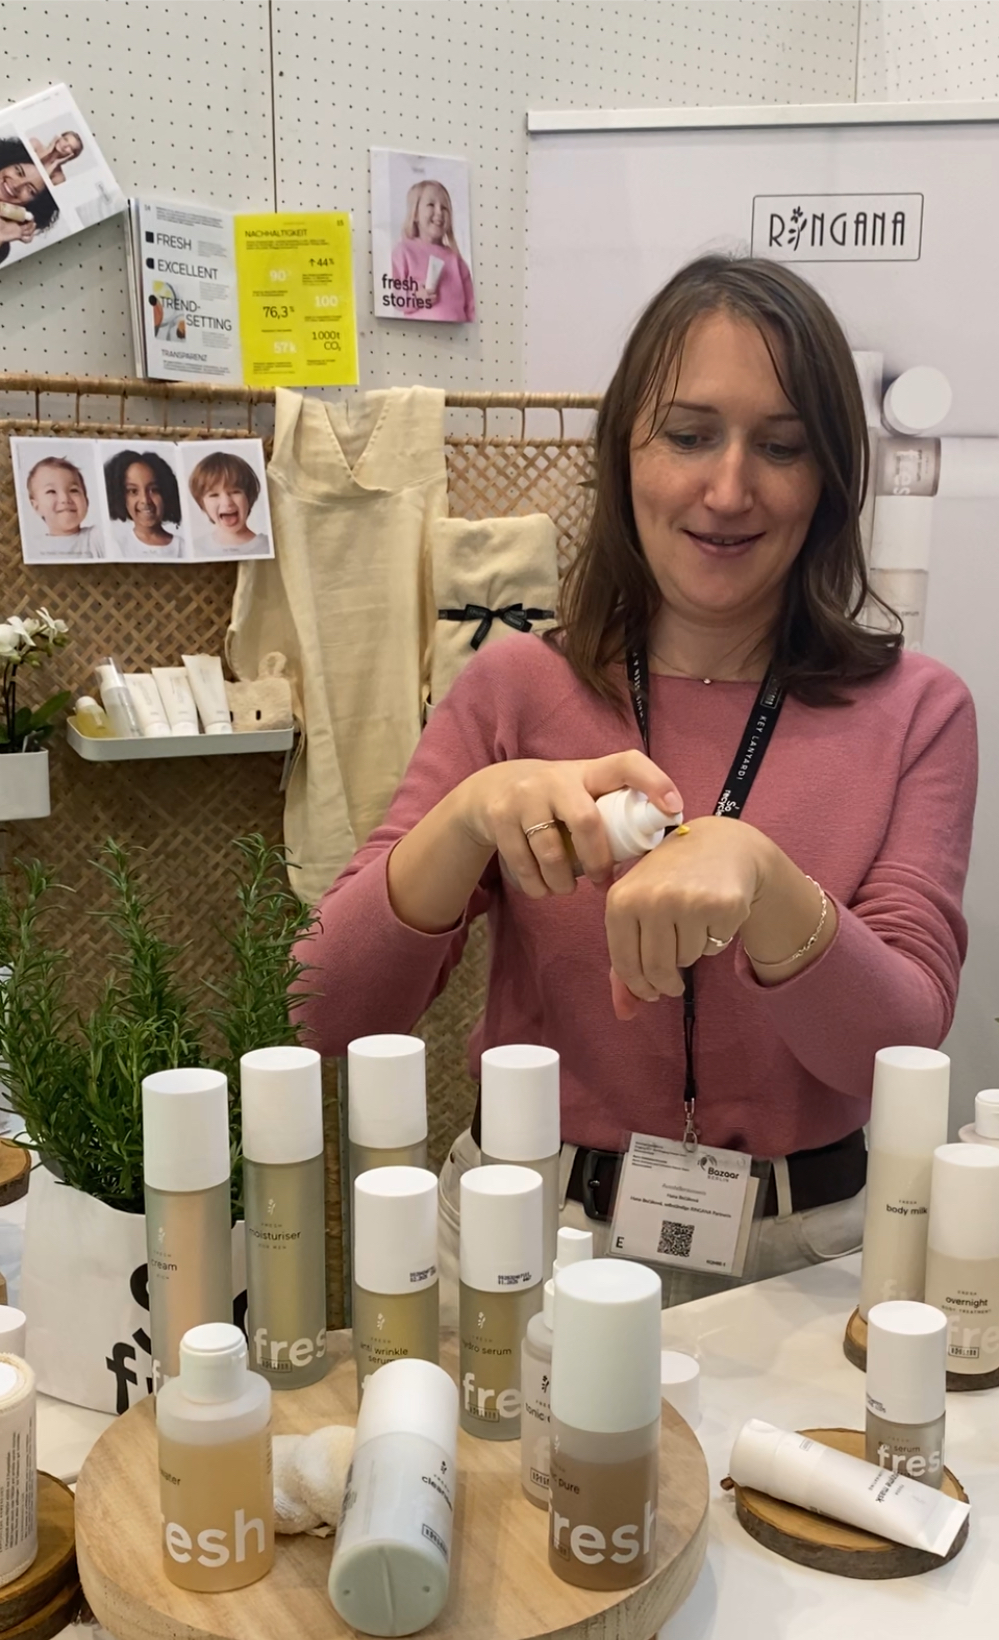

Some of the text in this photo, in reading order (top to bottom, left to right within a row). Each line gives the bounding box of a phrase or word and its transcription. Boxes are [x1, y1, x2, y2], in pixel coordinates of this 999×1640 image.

[156, 232, 192, 251] FRESH
[245, 229, 307, 238] NACHHALTIGKEIT
[157, 259, 218, 280] EXCELLENT
[381, 274, 418, 292] fresh
[160, 296, 201, 313] TREND-
[382, 293, 432, 310] stories
[186, 315, 232, 332] SETTING
[756, 715, 767, 733] KEY
[707, 1167, 740, 1180] Bazaar
[886, 1204, 928, 1216] body milk
[249, 1227, 302, 1242] moisturiser
[616, 1236, 625, 1249] E
[151, 1258, 178, 1272] cream
[945, 1296, 989, 1308] overnight
[374, 1347, 409, 1356] wrinkle
[482, 1346, 512, 1356] serum
[525, 1402, 545, 1421] tonic
[877, 1438, 946, 1477] fres
[894, 1445, 921, 1453] serum
[558, 1476, 580, 1495] pure
[161, 1508, 266, 1568] esh
